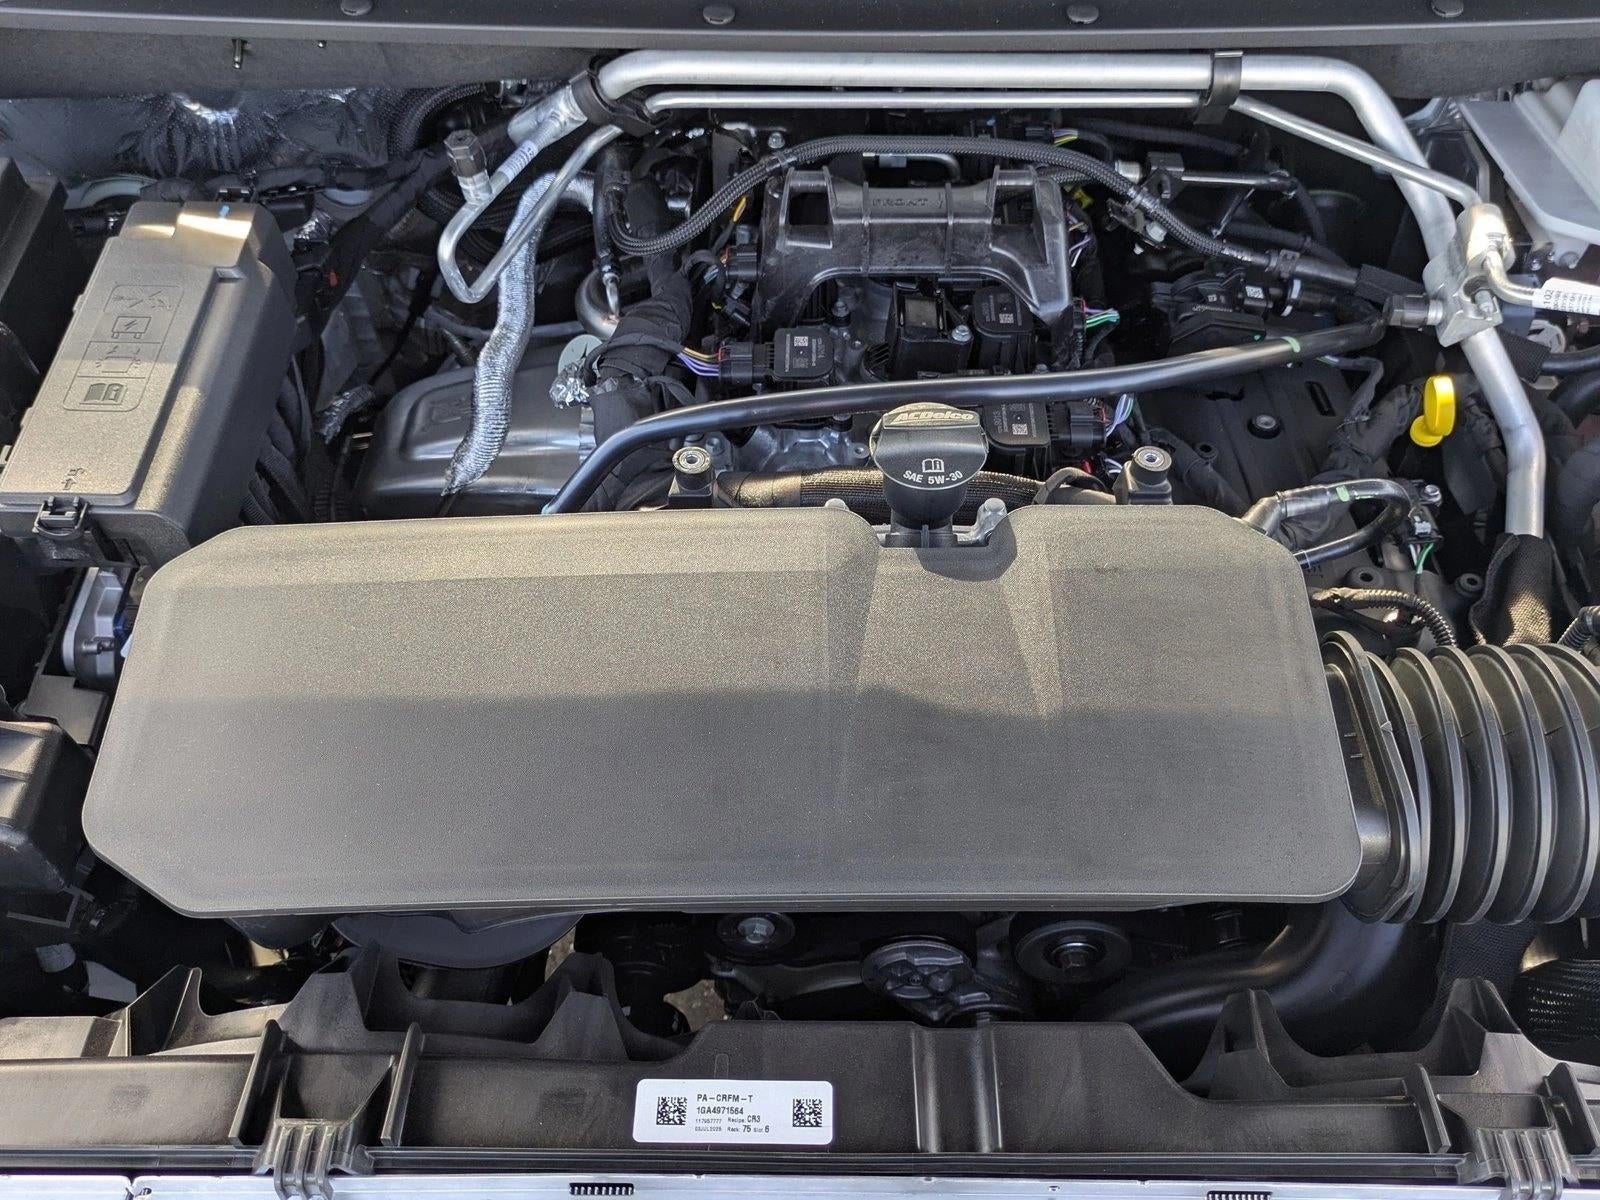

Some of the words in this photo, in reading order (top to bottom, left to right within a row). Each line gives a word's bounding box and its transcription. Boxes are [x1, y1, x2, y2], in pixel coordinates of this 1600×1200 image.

[890, 410, 974, 424] ACDelco
[903, 470, 924, 483] SAE
[928, 470, 963, 485] 5W-30
[747, 1114, 761, 1123] CR3
[742, 1124, 752, 1133] 75
[764, 1125, 770, 1133] 6
